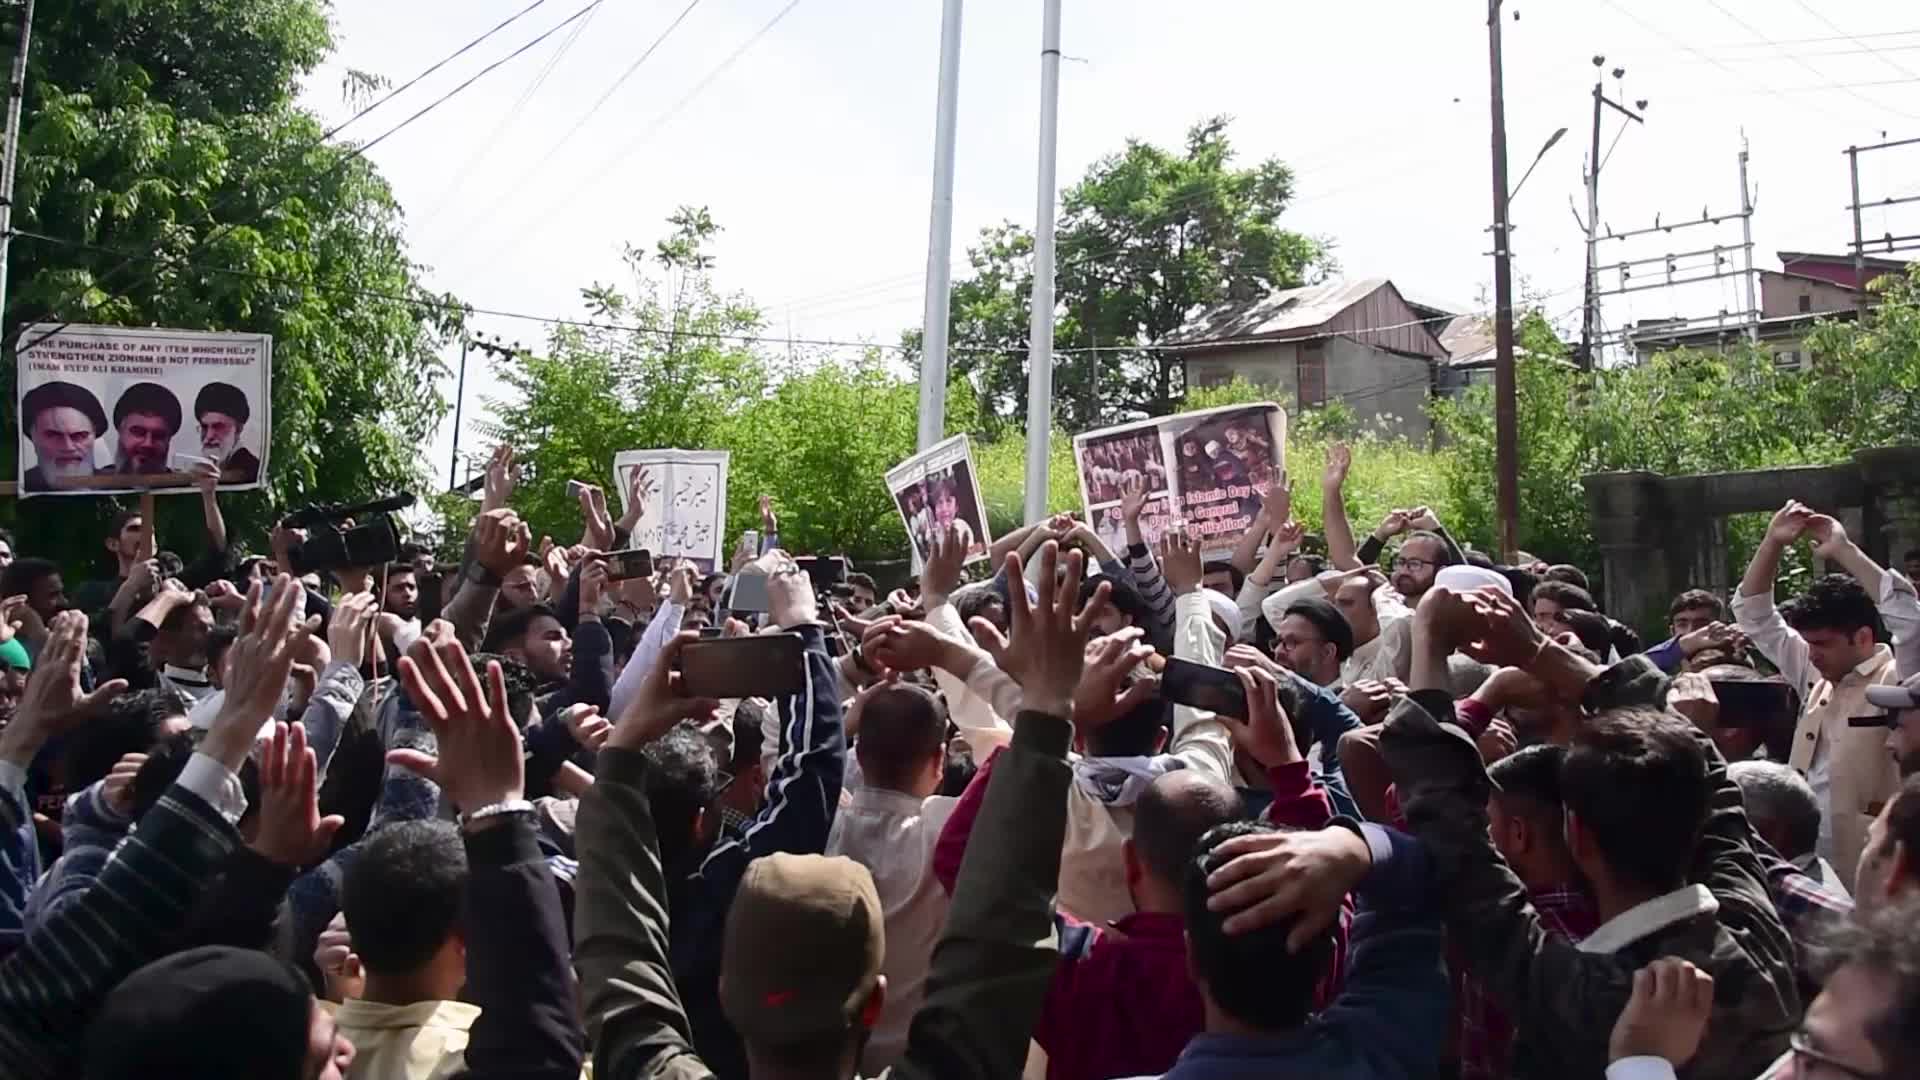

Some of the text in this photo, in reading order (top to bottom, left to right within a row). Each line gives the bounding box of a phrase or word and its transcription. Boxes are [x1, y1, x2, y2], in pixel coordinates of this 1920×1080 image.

[59, 340, 120, 351] PURCHASE
[141, 344, 161, 353] ANY
[165, 345, 189, 353] ITEM
[192, 346, 224, 354] WHICH
[28, 351, 104, 362] STRENGTHEN
[108, 354, 153, 363] ZIONISM
[157, 356, 167, 364] IS
[170, 357, 189, 365] NOT
[92, 366, 107, 374] ALI
[1185, 488, 1227, 505] Islamic
[1227, 485, 1251, 499] Day
[1194, 501, 1240, 519] General
